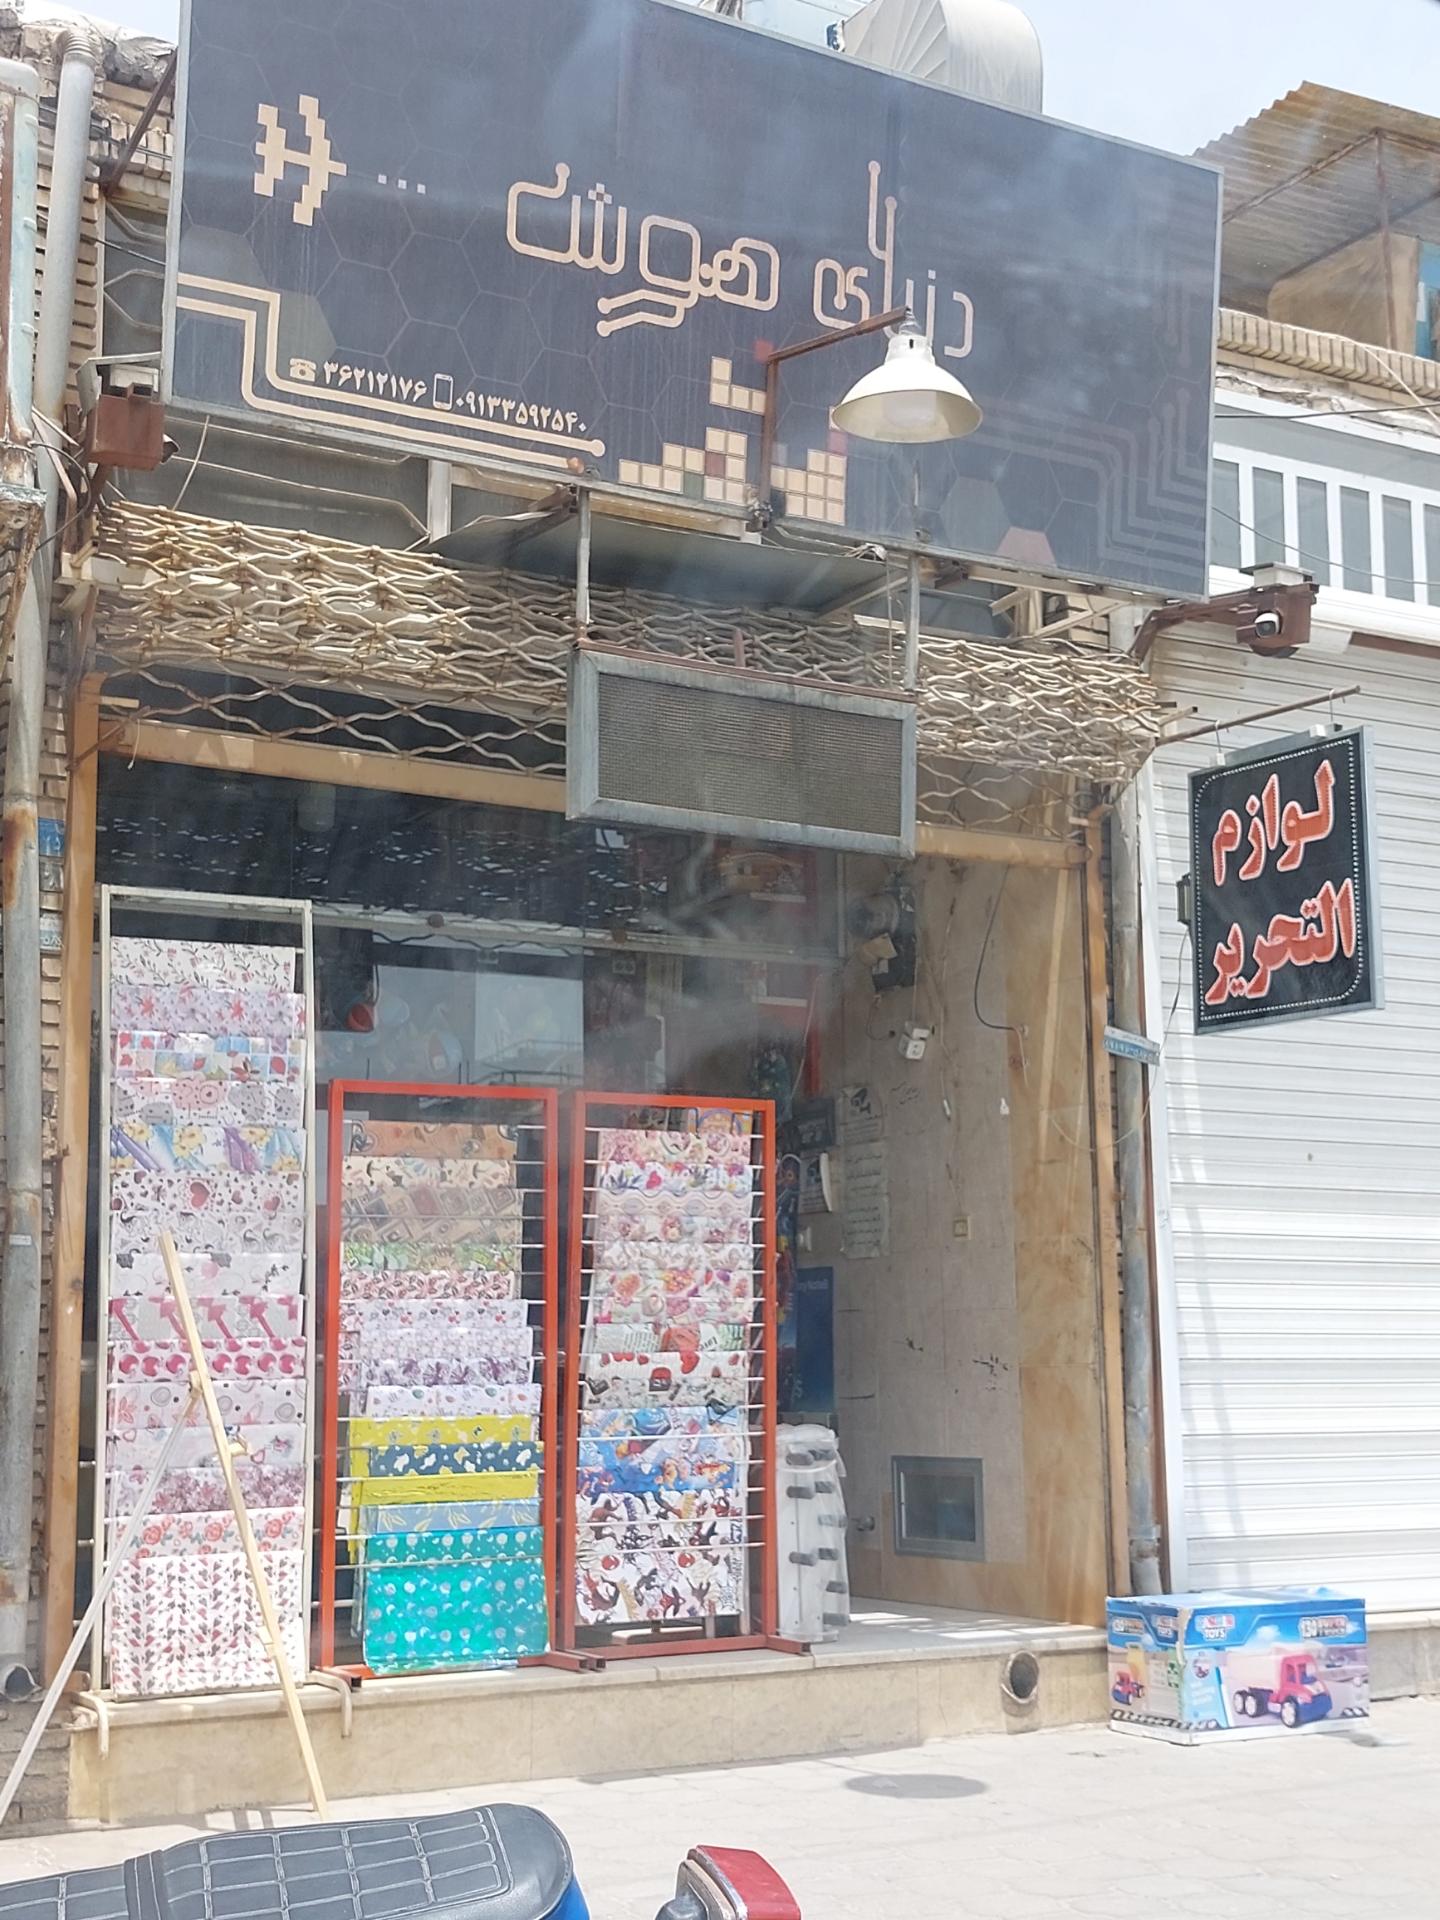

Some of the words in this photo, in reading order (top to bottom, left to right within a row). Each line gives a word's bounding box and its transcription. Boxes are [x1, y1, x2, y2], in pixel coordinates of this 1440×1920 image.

[323, 360, 428, 403] ۳۶۲۱۲۱۷۶
[455, 390, 588, 434] ۰۹۱۳۳۵۹۲۵۴۰
[1211, 758, 1336, 887] لوازم
[1204, 877, 1356, 1006] التحریر
